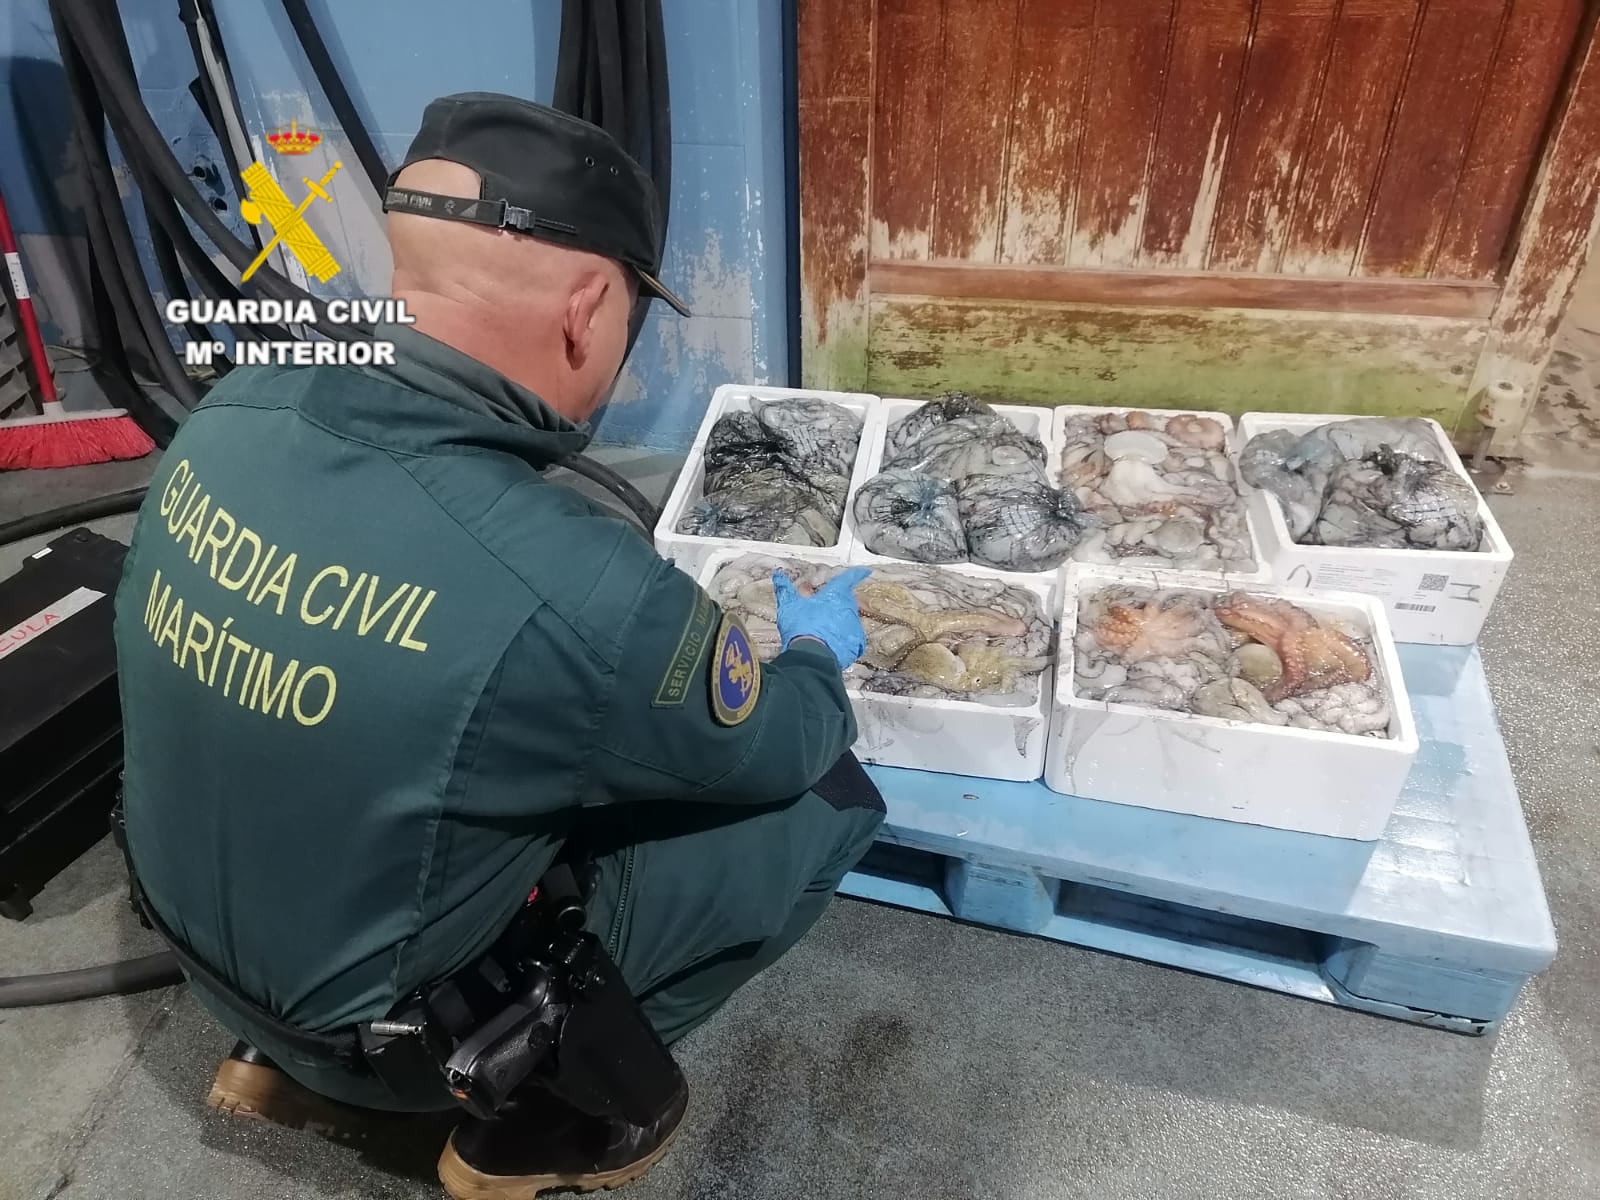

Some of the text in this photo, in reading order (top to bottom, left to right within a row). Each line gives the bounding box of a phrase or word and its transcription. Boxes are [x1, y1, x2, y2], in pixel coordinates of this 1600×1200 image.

[160, 459, 437, 652] GUARDIA CIVIL
[144, 569, 338, 726] MARÍTIMO
[669, 632, 701, 697] SERVICIO
